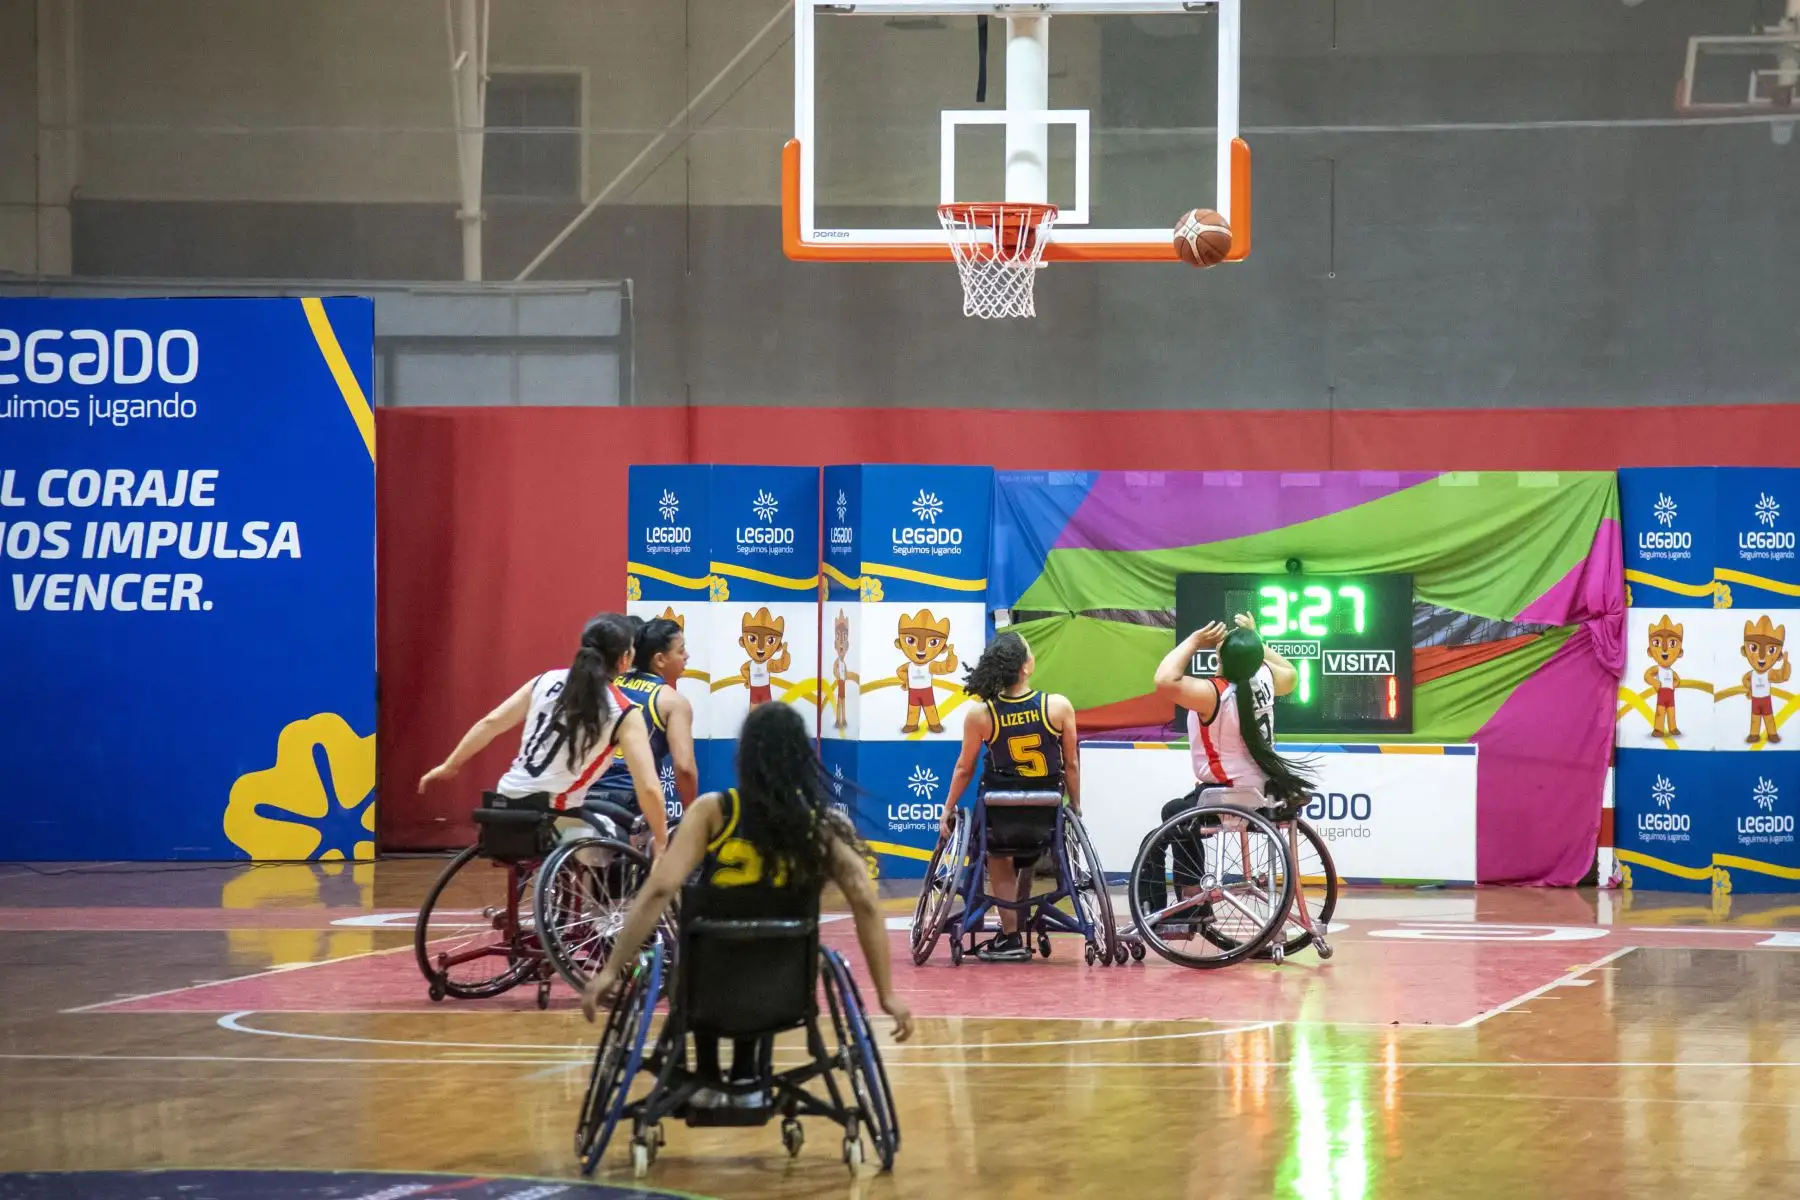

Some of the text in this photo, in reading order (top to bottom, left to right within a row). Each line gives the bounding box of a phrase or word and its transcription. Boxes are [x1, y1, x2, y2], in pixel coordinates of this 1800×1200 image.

[89, 392, 197, 427] jugando
[0, 469, 219, 507] L CORAJE
[82, 521, 301, 559] IMPULSA
[12, 573, 214, 611] VENCER.
[1259, 586, 1366, 637] 3:27
[1271, 644, 1317, 656] PERIODO
[1327, 653, 1391, 672] VISITA
[613, 675, 658, 693] GLADYS
[1299, 659, 1310, 703] 1
[1388, 676, 1398, 719] 1
[1000, 709, 1040, 727] LIZETH
[1007, 733, 1048, 777] 5
[887, 803, 946, 820] LEGAD
[888, 821, 925, 832] Seguimos
